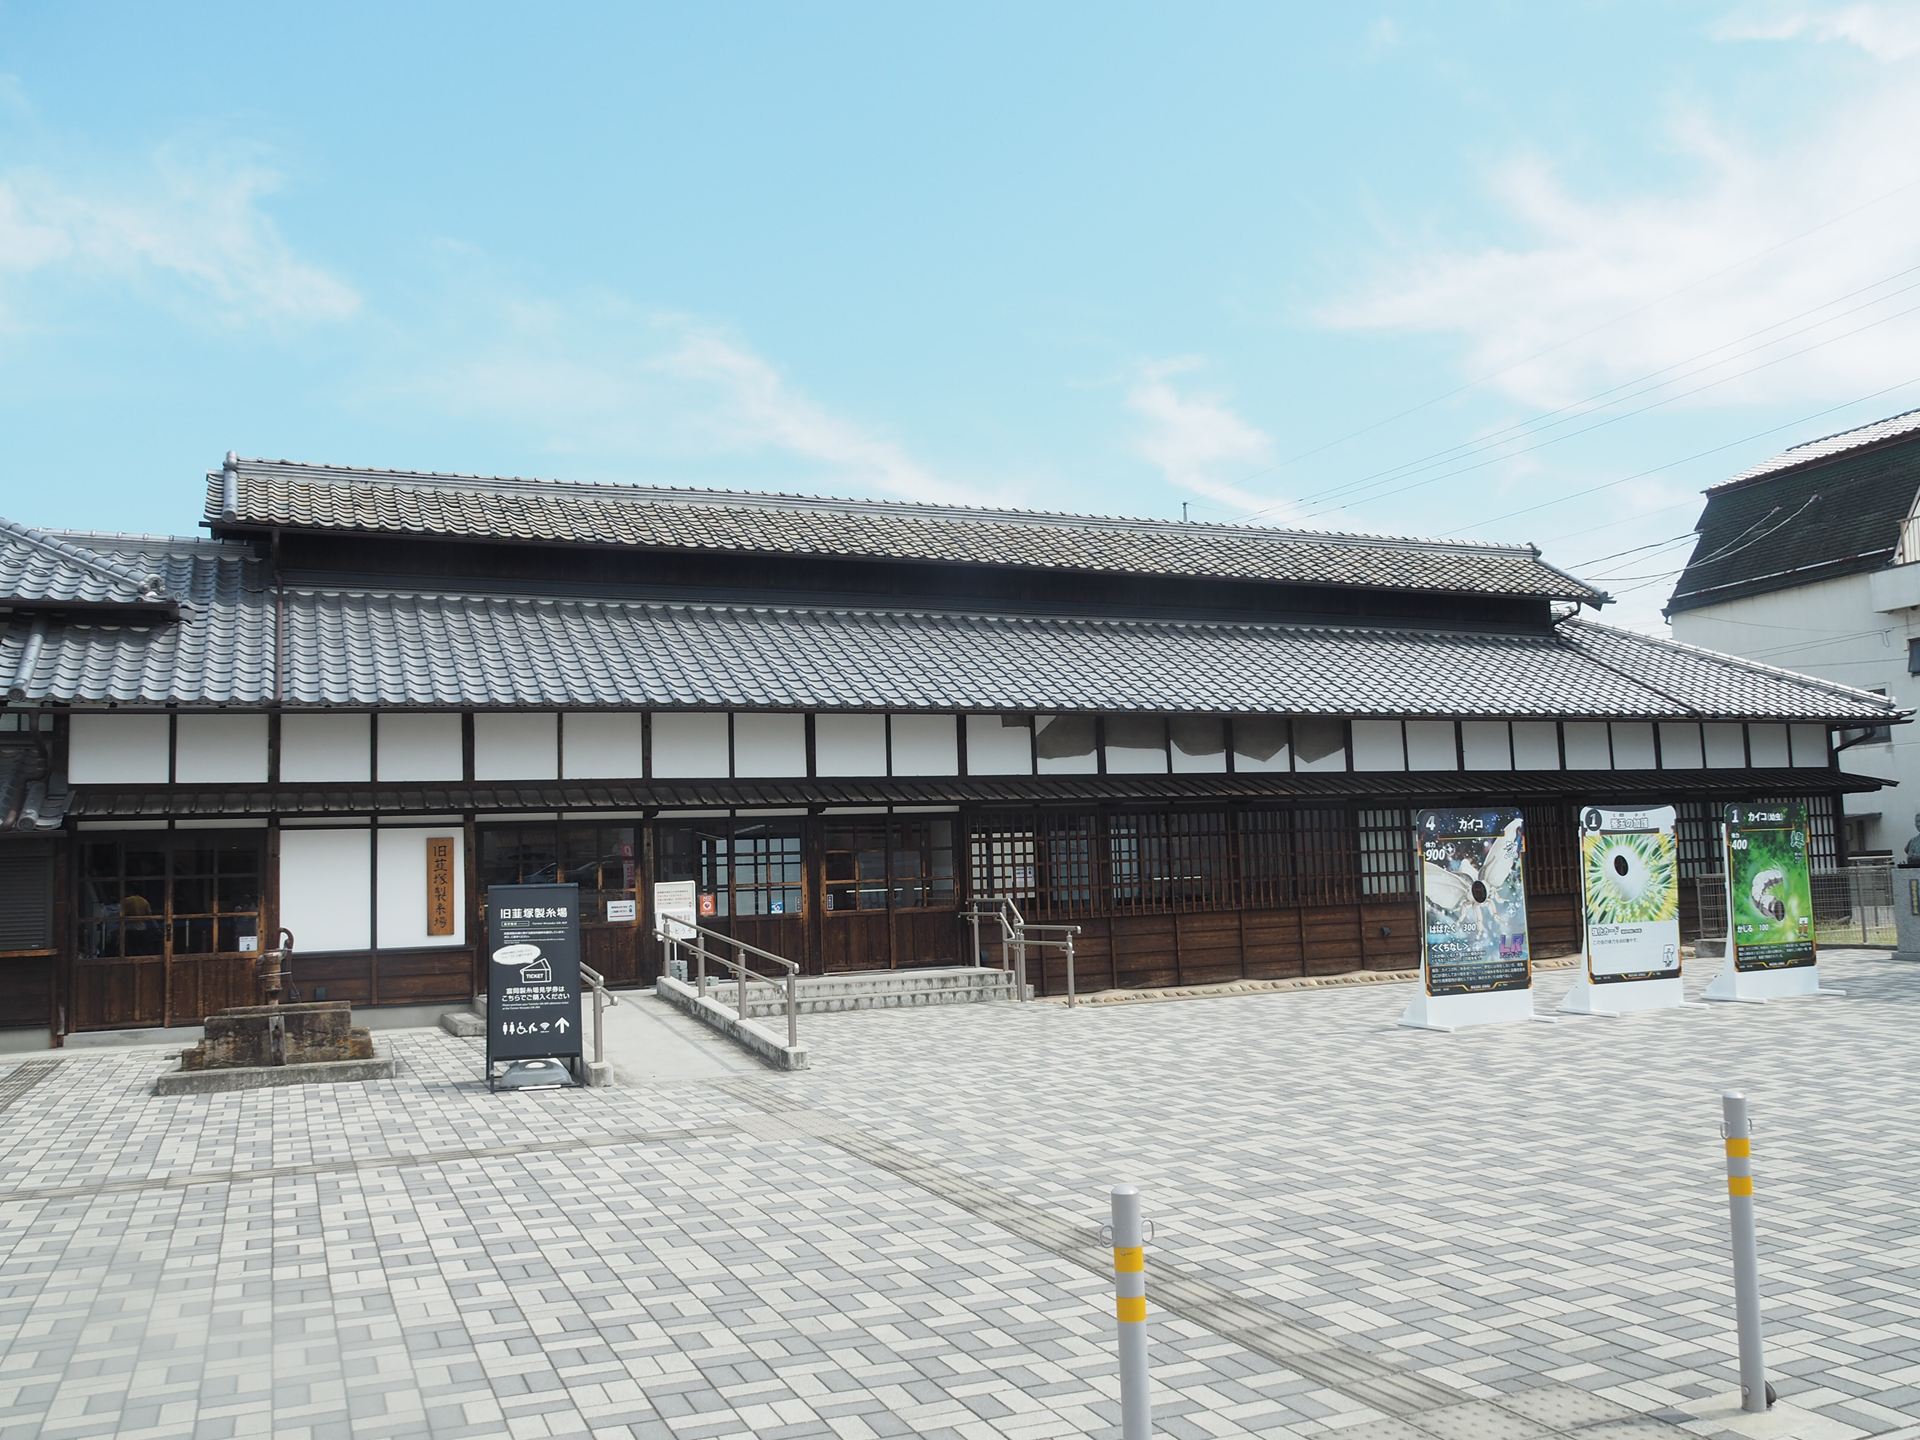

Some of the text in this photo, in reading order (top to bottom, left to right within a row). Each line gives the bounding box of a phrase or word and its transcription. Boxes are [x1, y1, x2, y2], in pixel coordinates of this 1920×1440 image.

[1589, 813, 1597, 827] 1
[1731, 809, 1739, 823] 1
[1425, 815, 1436, 830] 4
[1458, 818, 1483, 830] カイコ
[1731, 839, 1748, 850] 400
[1425, 848, 1445, 861] 900
[1429, 923, 1476, 934] はばたく 300
[501, 993, 570, 1002] こちらでご購入ください
